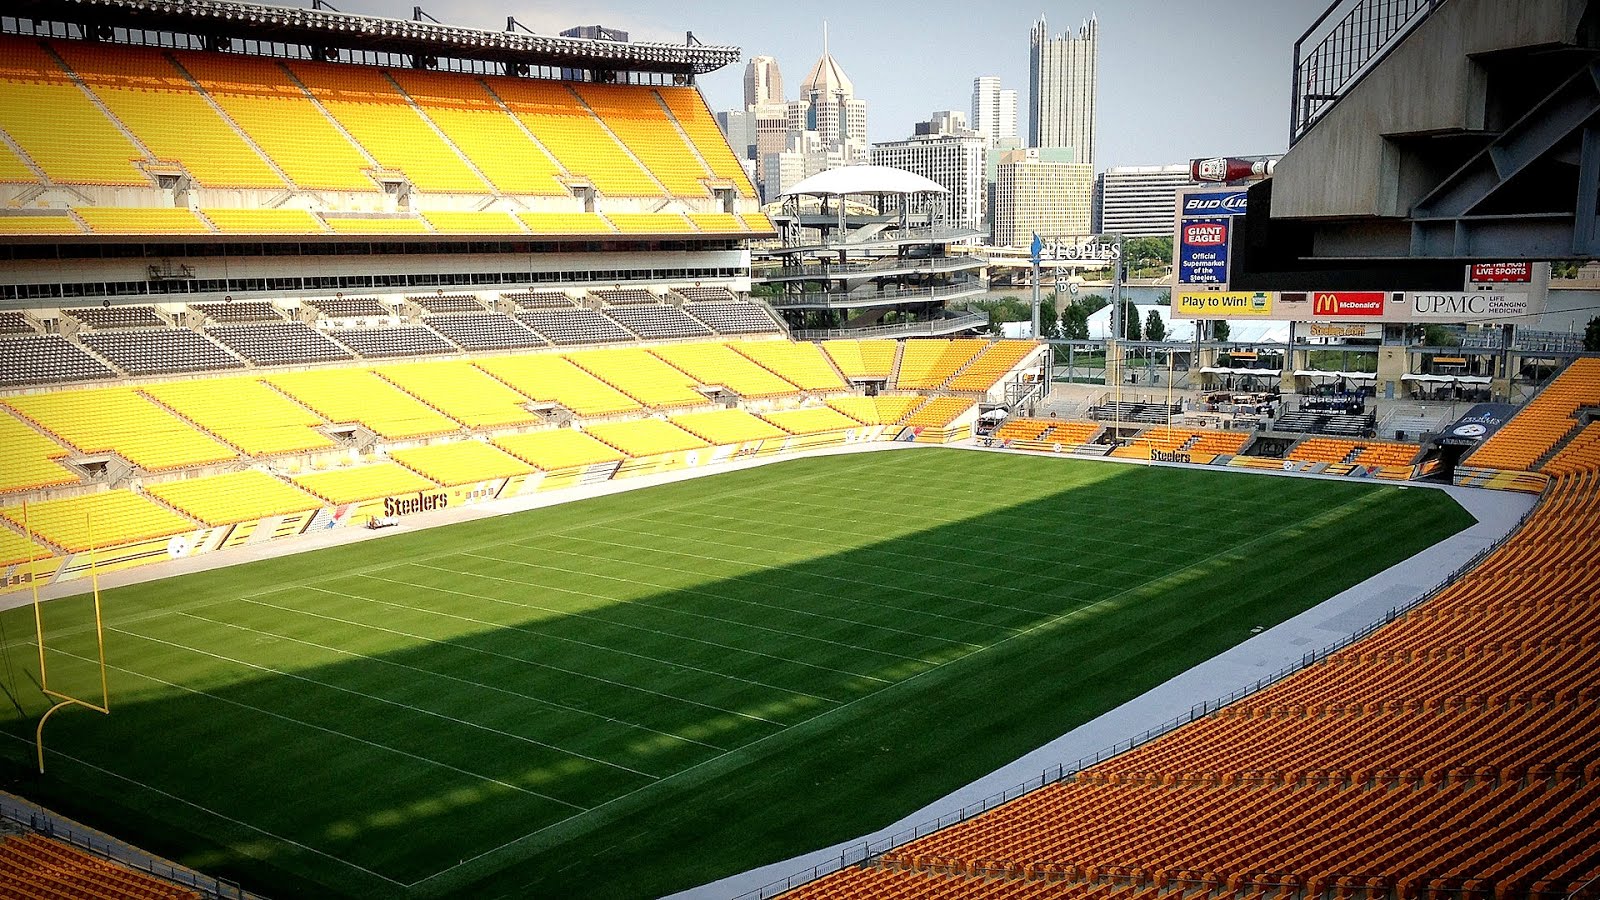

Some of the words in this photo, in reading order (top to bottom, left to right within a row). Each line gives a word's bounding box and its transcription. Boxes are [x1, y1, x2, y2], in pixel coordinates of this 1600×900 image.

[1185, 199, 1221, 209] BUD
[1188, 227, 1222, 235] GIANT
[1188, 235, 1221, 243] EAGLE
[1045, 243, 1121, 260] PEOPLES
[1182, 260, 1225, 268] Supermarket
[1182, 296, 1206, 309] Play
[1208, 297, 1219, 306] to
[1222, 296, 1247, 307] Win!
[1339, 301, 1380, 309] McDonald's
[1414, 295, 1486, 314] UPMC
[1151, 449, 1191, 463] Steelers
[383, 491, 448, 518] Steelers
